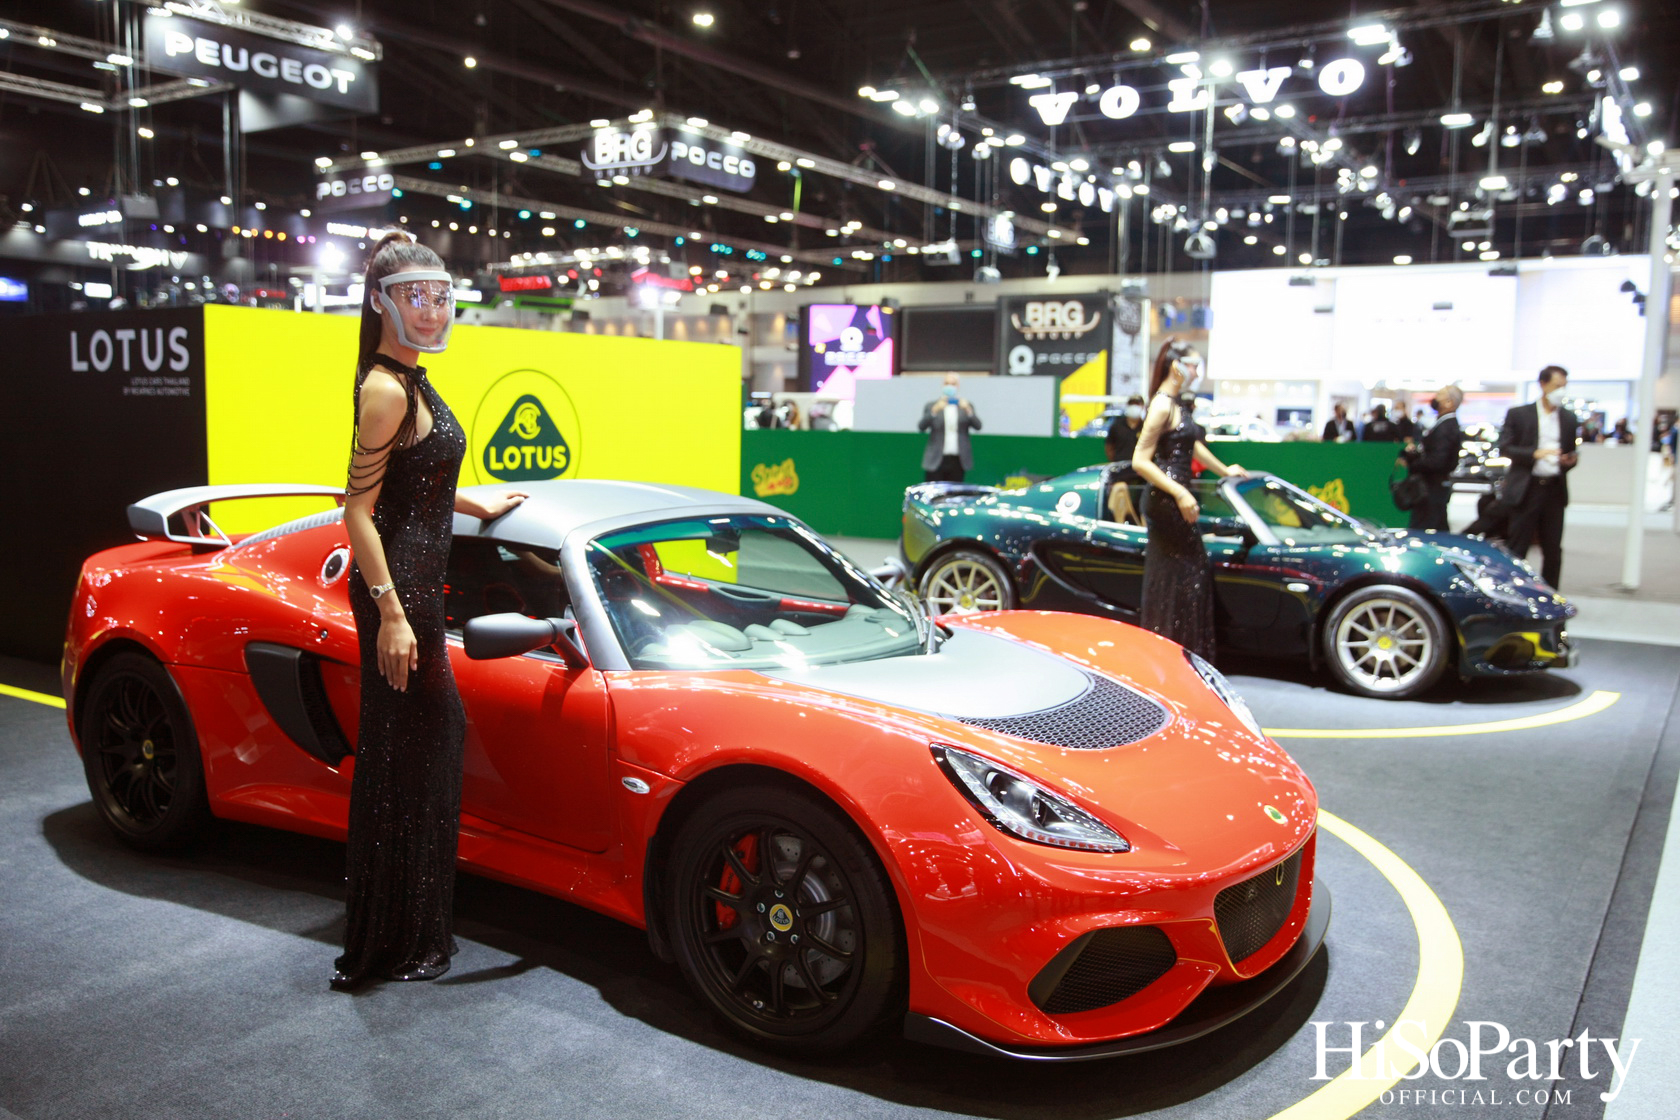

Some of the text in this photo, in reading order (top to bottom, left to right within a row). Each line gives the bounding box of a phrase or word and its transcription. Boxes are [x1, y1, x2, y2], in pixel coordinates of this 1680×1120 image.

[164, 30, 355, 94] PEUGEOT
[1029, 58, 1365, 125] VOLVO
[594, 129, 652, 165] BRG
[671, 141, 756, 178] POCCO
[316, 173, 394, 200] POCCO
[1025, 300, 1084, 328] BRG
[70, 326, 190, 372] LOTUS
[489, 445, 567, 470] LOTUS
